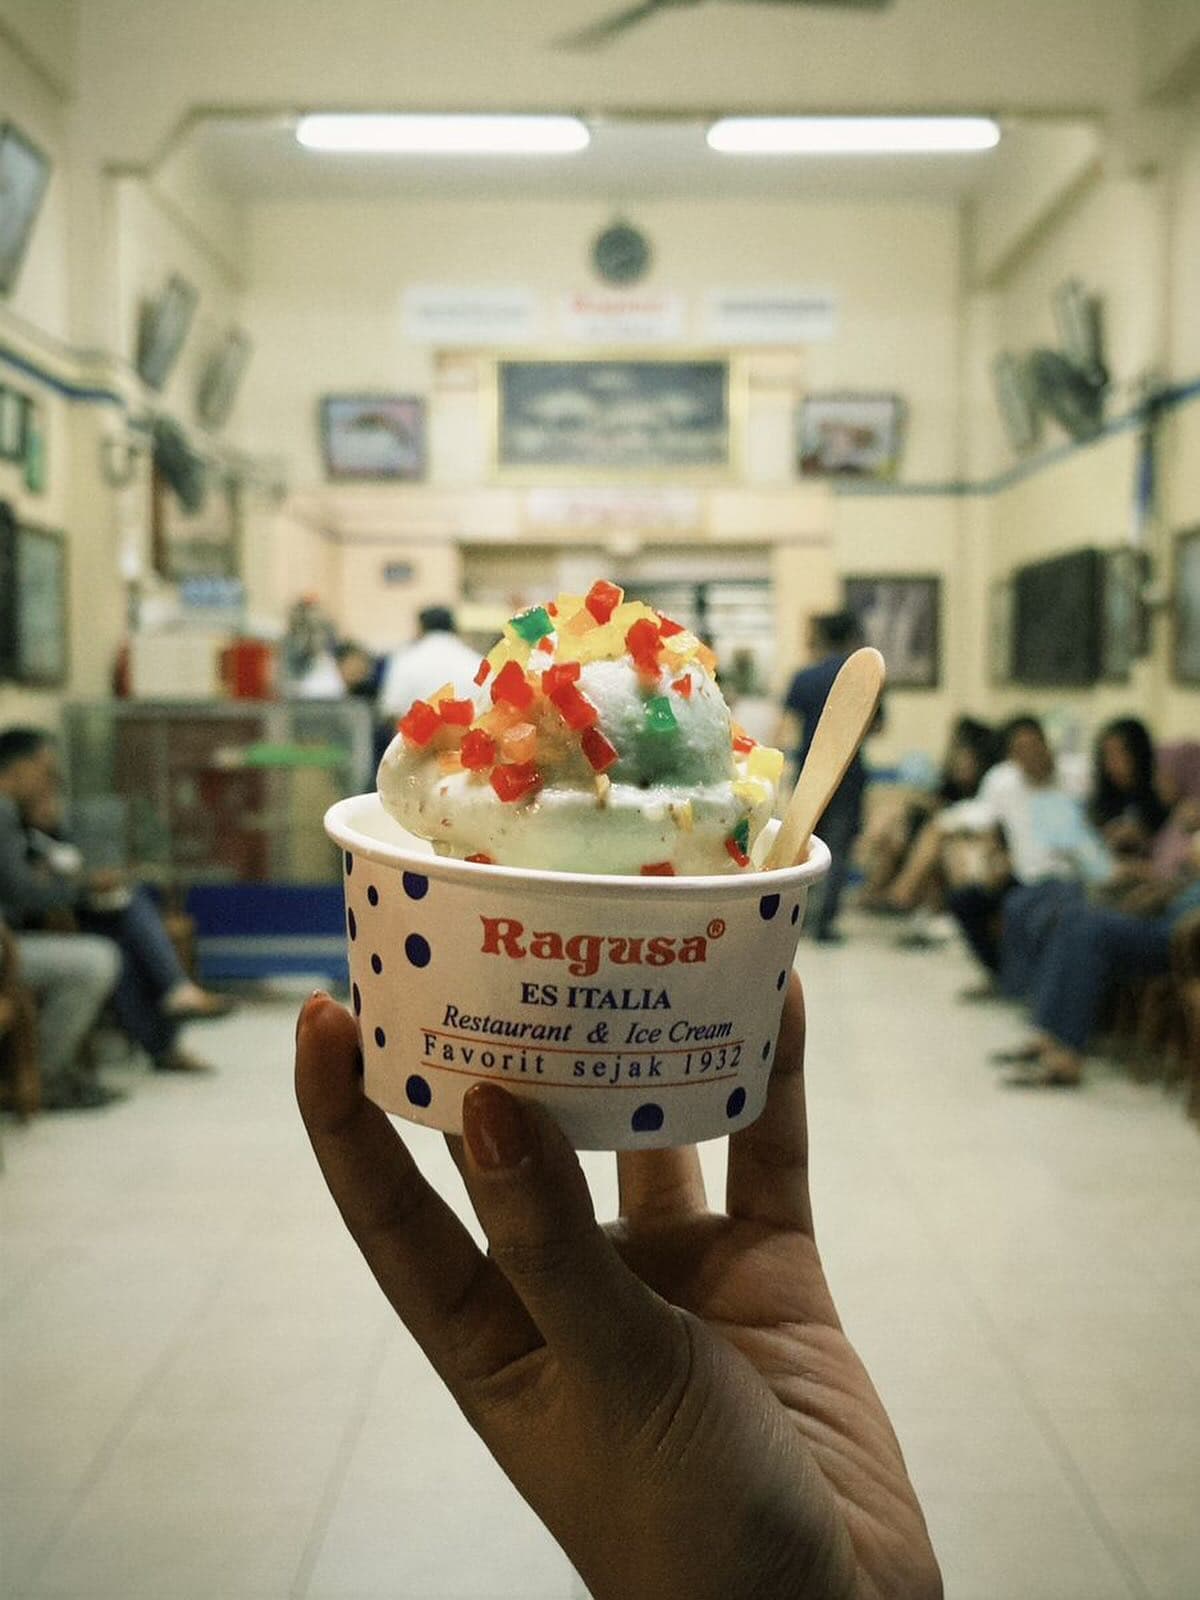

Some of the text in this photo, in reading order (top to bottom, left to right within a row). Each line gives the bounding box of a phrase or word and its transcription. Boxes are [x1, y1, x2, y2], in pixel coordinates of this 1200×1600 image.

[520, 982, 672, 1010] ES ITALIA
[441, 1004, 733, 1045] Restaurant & Ice Cream
[424, 1033, 743, 1084] Favorit sejak 1932
